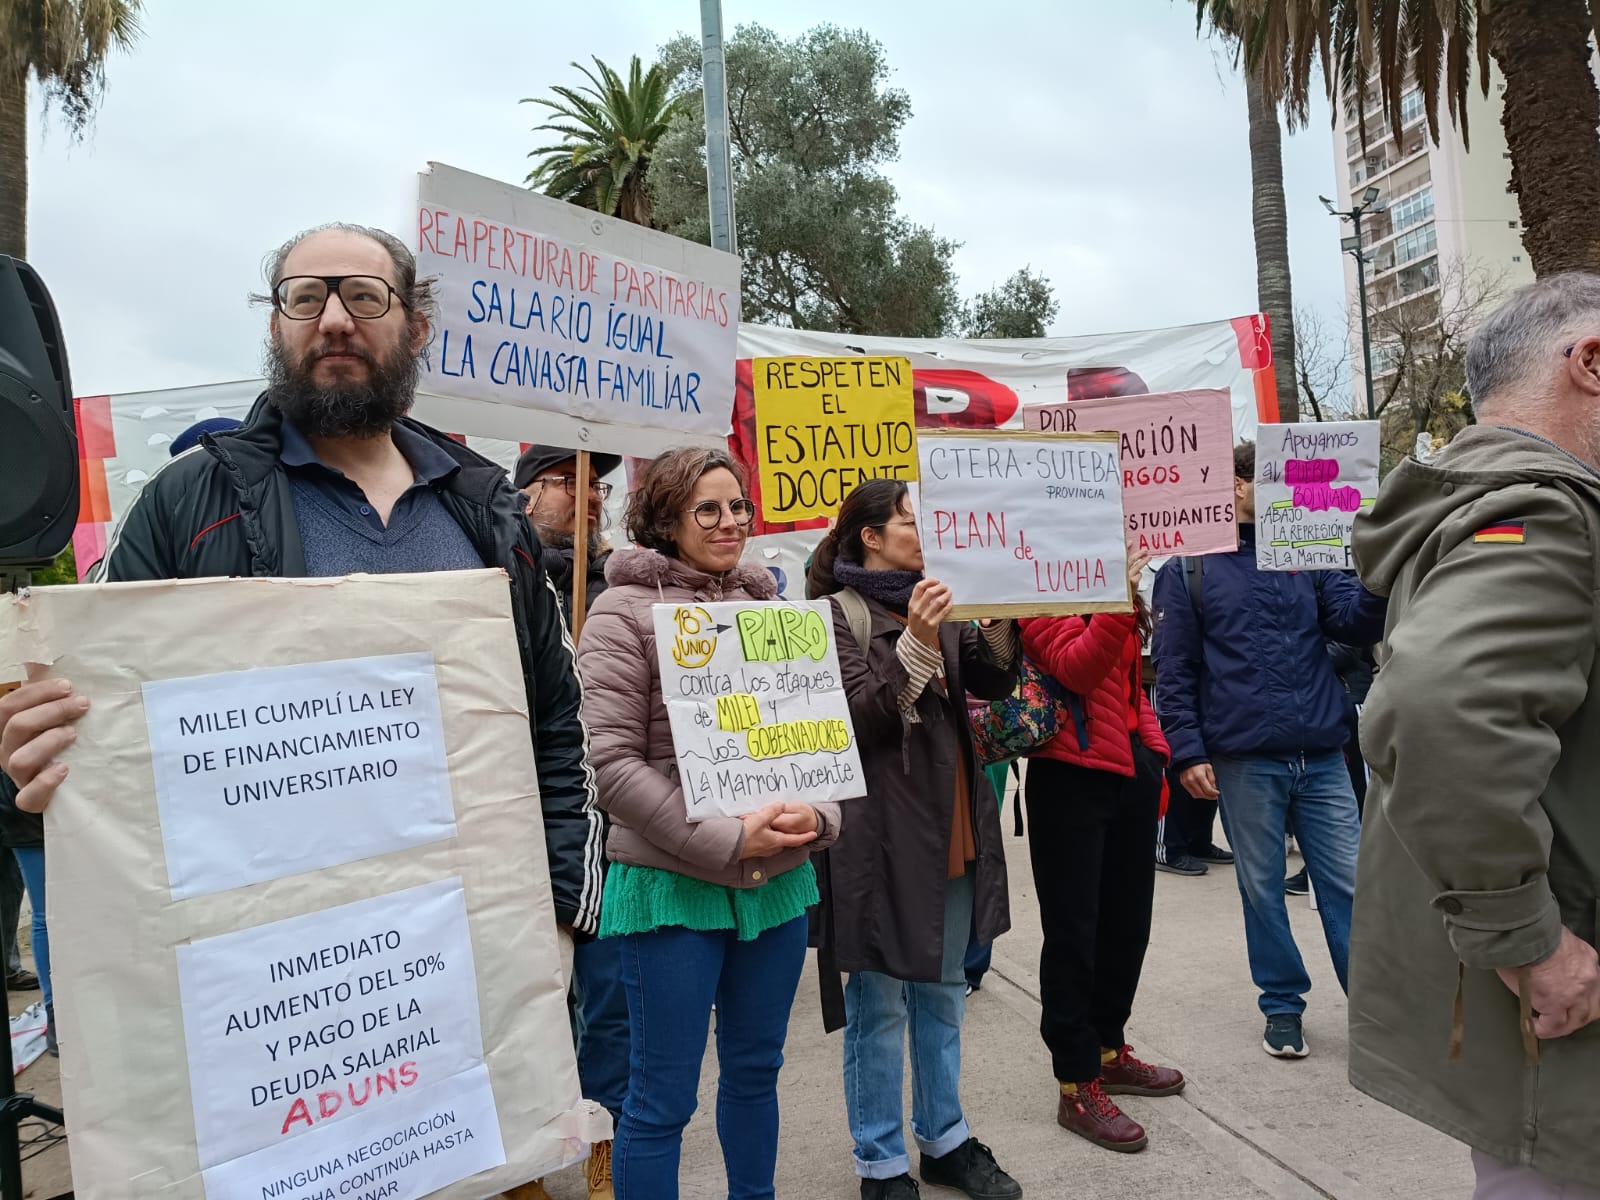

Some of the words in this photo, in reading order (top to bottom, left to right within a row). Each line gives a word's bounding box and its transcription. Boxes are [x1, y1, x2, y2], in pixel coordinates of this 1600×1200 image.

[419, 207, 574, 290] REAPERTURA
[579, 252, 600, 295] DE
[467, 280, 592, 343] SALARIO
[605, 303, 673, 359] IGUAL
[441, 330, 475, 378] LA
[490, 341, 589, 399] CANASTA
[598, 360, 702, 414] FAMILIAR
[767, 361, 901, 389] RESPETEN
[822, 394, 847, 414] EL
[766, 421, 913, 464] ESTATUTO
[1120, 416, 1198, 461] ACIÓN
[1282, 428, 1359, 460] Apoyamos
[929, 447, 1022, 481] CTERA
[1036, 448, 1120, 485] SUTEBA
[1123, 465, 1181, 489] RGOS
[1046, 485, 1105, 499] PROVINCIA
[934, 510, 1006, 551] PLAN
[1124, 503, 1235, 531] STUDIANTES
[1273, 524, 1287, 541] LA
[1290, 519, 1344, 541] REPRESIÓN
[1014, 530, 1034, 561] de
[1139, 530, 1185, 551] AULA
[1035, 558, 1107, 593] LUCHA
[671, 636, 712, 662] JUNIO
[673, 606, 701, 636] 18
[735, 607, 828, 662] PARO
[679, 666, 732, 696] contra
[741, 668, 770, 692] los
[776, 663, 834, 705] ataques
[179, 708, 248, 736] MILEI
[255, 691, 342, 725] CUMPLÍ
[348, 693, 375, 713] LA
[380, 687, 415, 708] LEY
[694, 703, 713, 727] de
[717, 695, 761, 730] MILEI
[183, 751, 217, 775] DE
[224, 721, 420, 768] FINANCIAMIENTO
[747, 720, 849, 758] GOBERNADORES
[223, 758, 398, 806] UNIVERSITARIO
[791, 757, 855, 791] Docente
[269, 930, 401, 983] INMEDIATO
[225, 982, 351, 1036] AUMENTO
[358, 968, 399, 996] DEL
[403, 952, 445, 982] 50%
[265, 1040, 280, 1062] Y
[288, 1020, 354, 1056] PAGO
[362, 1006, 391, 1033] DE
[397, 998, 422, 1023] LA
[250, 1063, 337, 1107] DEUDA
[342, 1026, 441, 1076] SALARIAL
[280, 1060, 420, 1135] ADUNS
[262, 1158, 344, 1200] NINGUNA
[347, 1110, 456, 1167] NEGOCIACIÓN
[339, 1151, 420, 1196] CONTINÚA
[423, 1128, 475, 1159] HASTA
